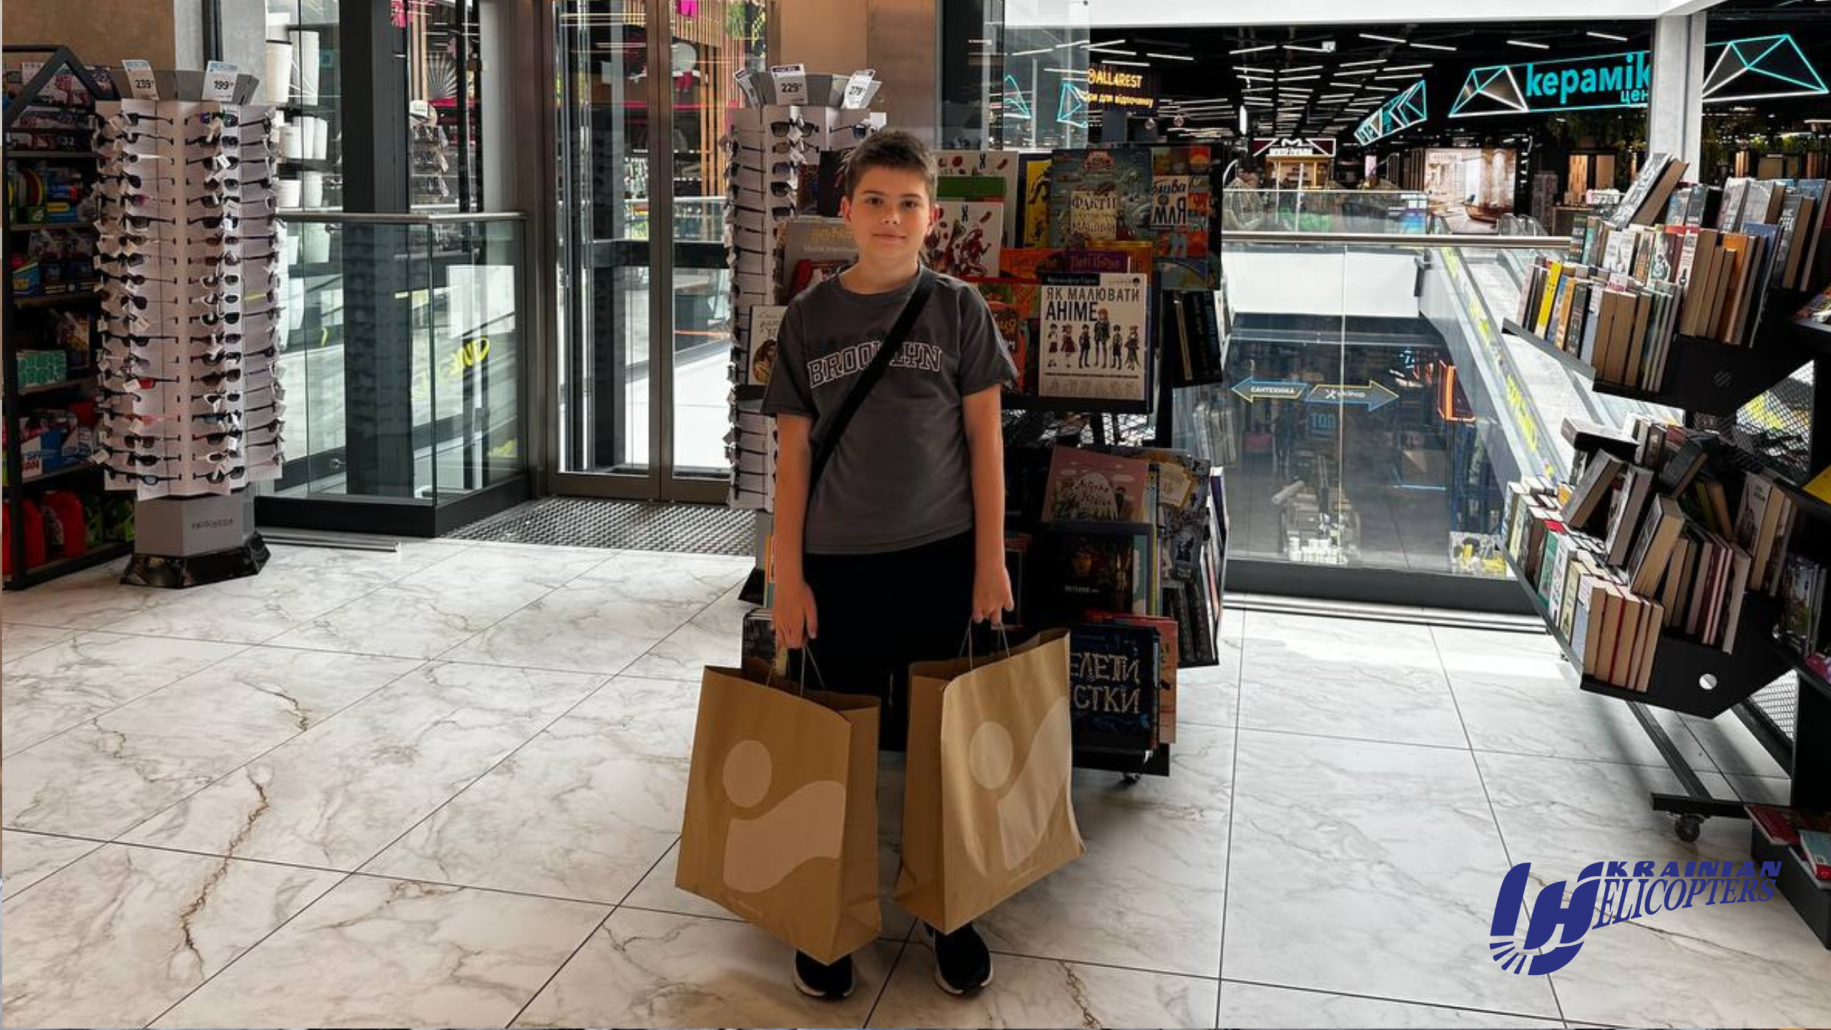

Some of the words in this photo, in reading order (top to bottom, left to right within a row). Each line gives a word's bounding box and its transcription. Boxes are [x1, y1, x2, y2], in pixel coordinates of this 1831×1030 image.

[213, 80, 229, 90] 199
[781, 83, 800, 93] 229
[1153, 196, 1187, 225] МЛЯ
[1046, 287, 1063, 301] ЯК
[1068, 287, 1141, 303] МАЛЮВАТИ
[1045, 300, 1098, 322] АНІМЕ
[807, 340, 942, 389] BROOLYN
[1070, 651, 1141, 684] ЕЛЕТИ
[1073, 684, 1141, 714] СТКИ
